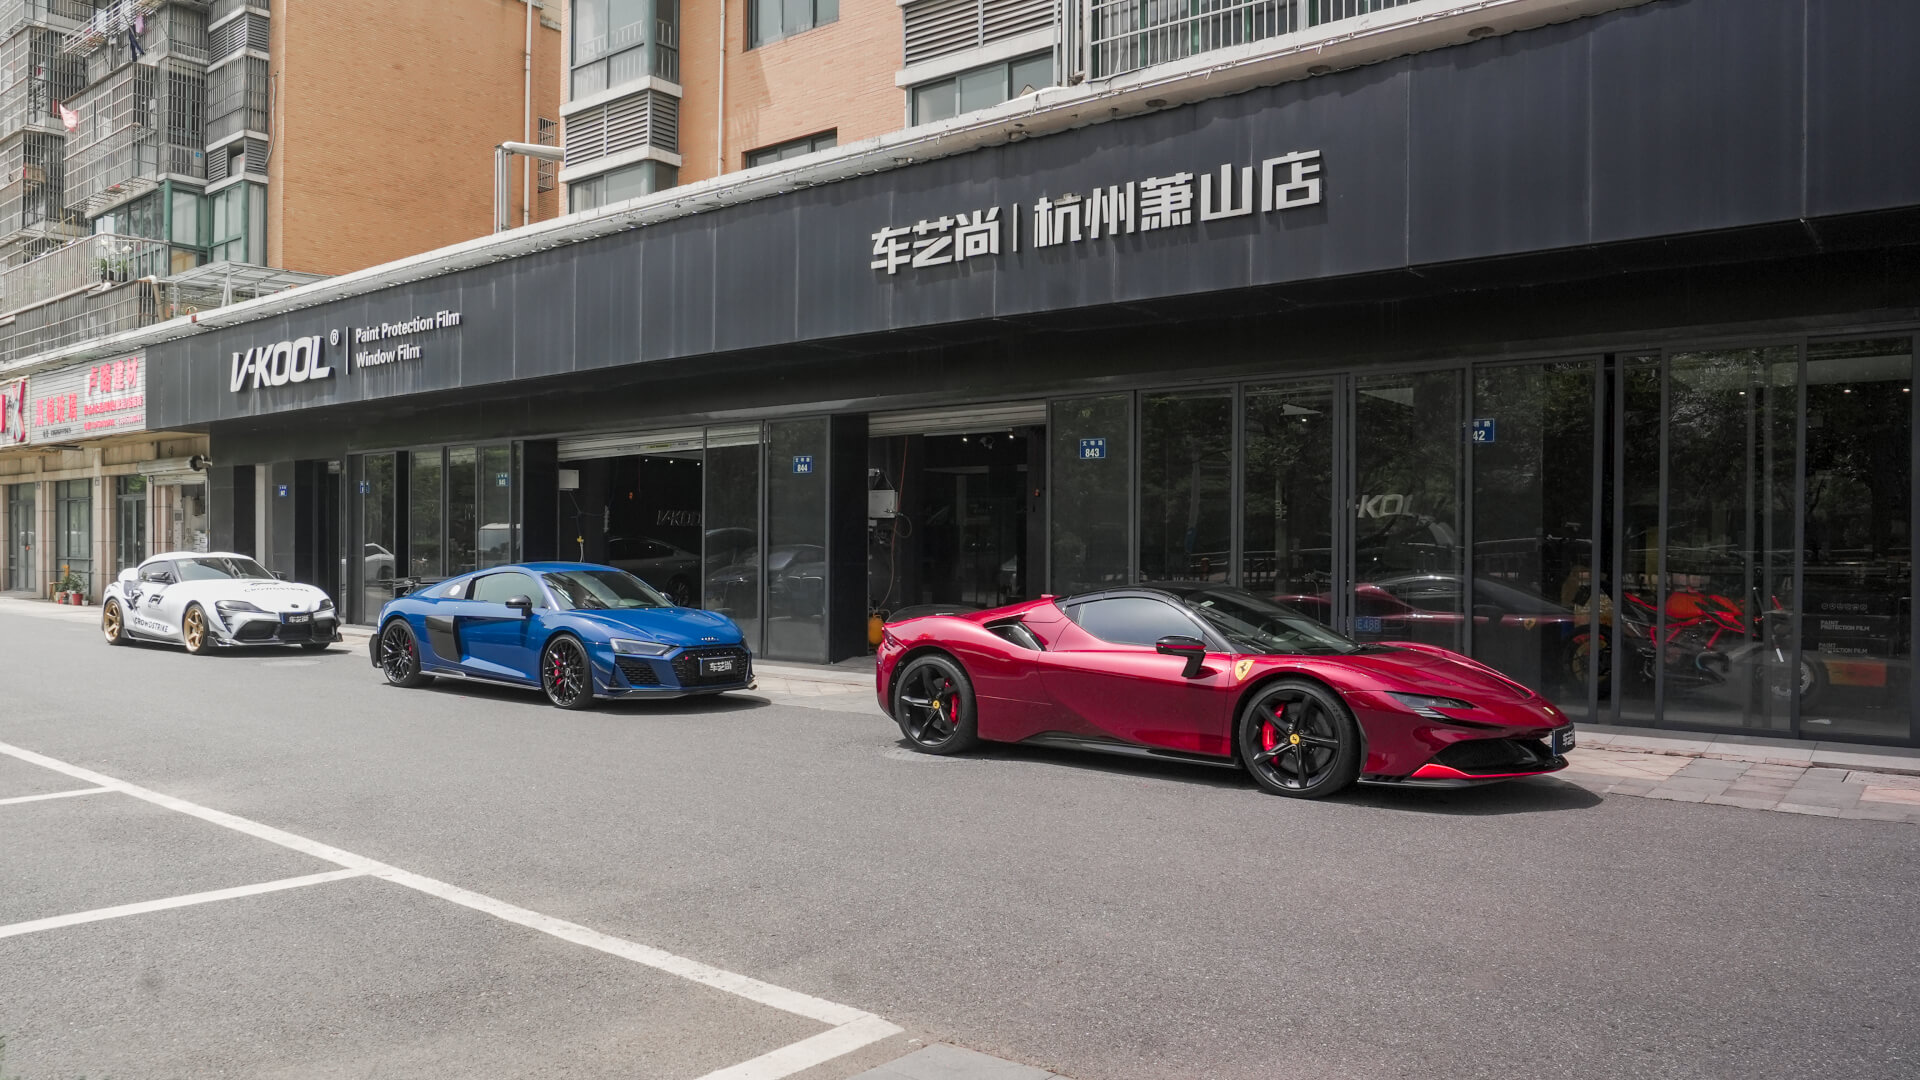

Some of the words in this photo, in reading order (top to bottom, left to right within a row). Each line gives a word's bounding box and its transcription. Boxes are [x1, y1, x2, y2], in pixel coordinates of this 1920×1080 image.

[871, 206, 1000, 275] 车艺尚
[1034, 149, 1321, 249] 杭州萧山店
[355, 326, 380, 344] Paint
[381, 316, 434, 339] Protection
[436, 310, 460, 329] Film
[230, 335, 331, 392] V-KOOL
[355, 349, 396, 368] Window
[397, 343, 421, 361] Film
[1472, 430, 1486, 441] 42
[1085, 447, 1100, 458] 843
[133, 617, 169, 633] CROWDSTRIKE
[709, 660, 732, 672] 车艺尚
